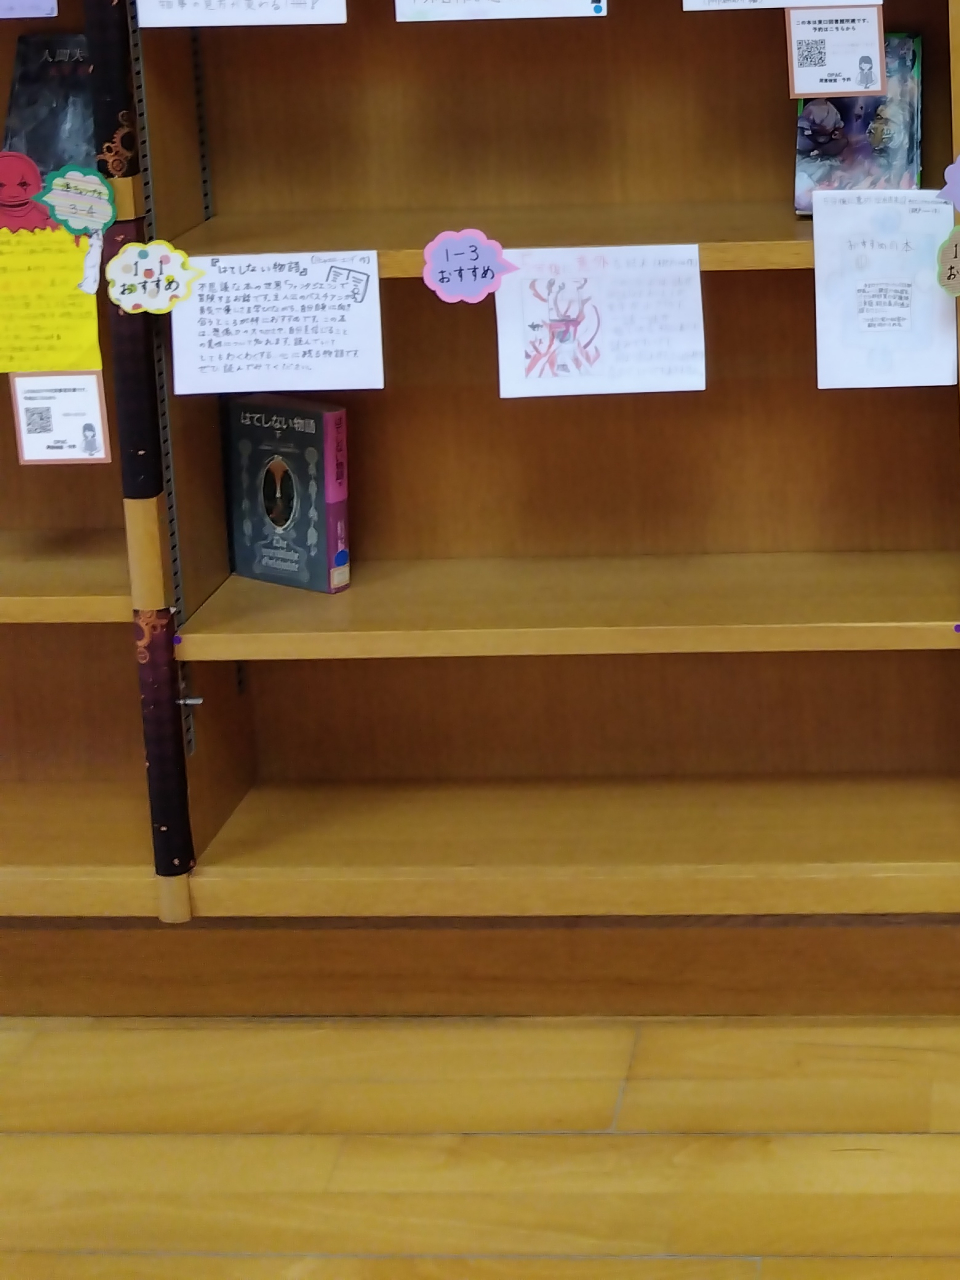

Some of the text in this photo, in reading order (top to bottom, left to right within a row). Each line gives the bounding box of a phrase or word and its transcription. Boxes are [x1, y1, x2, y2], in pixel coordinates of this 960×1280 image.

[446, 244, 480, 263] 1-3
[131, 260, 165, 280] 1-1
[438, 265, 495, 284] おすすめ
[120, 277, 181, 296] おすすめ
[239, 411, 317, 435] はてしない物語
